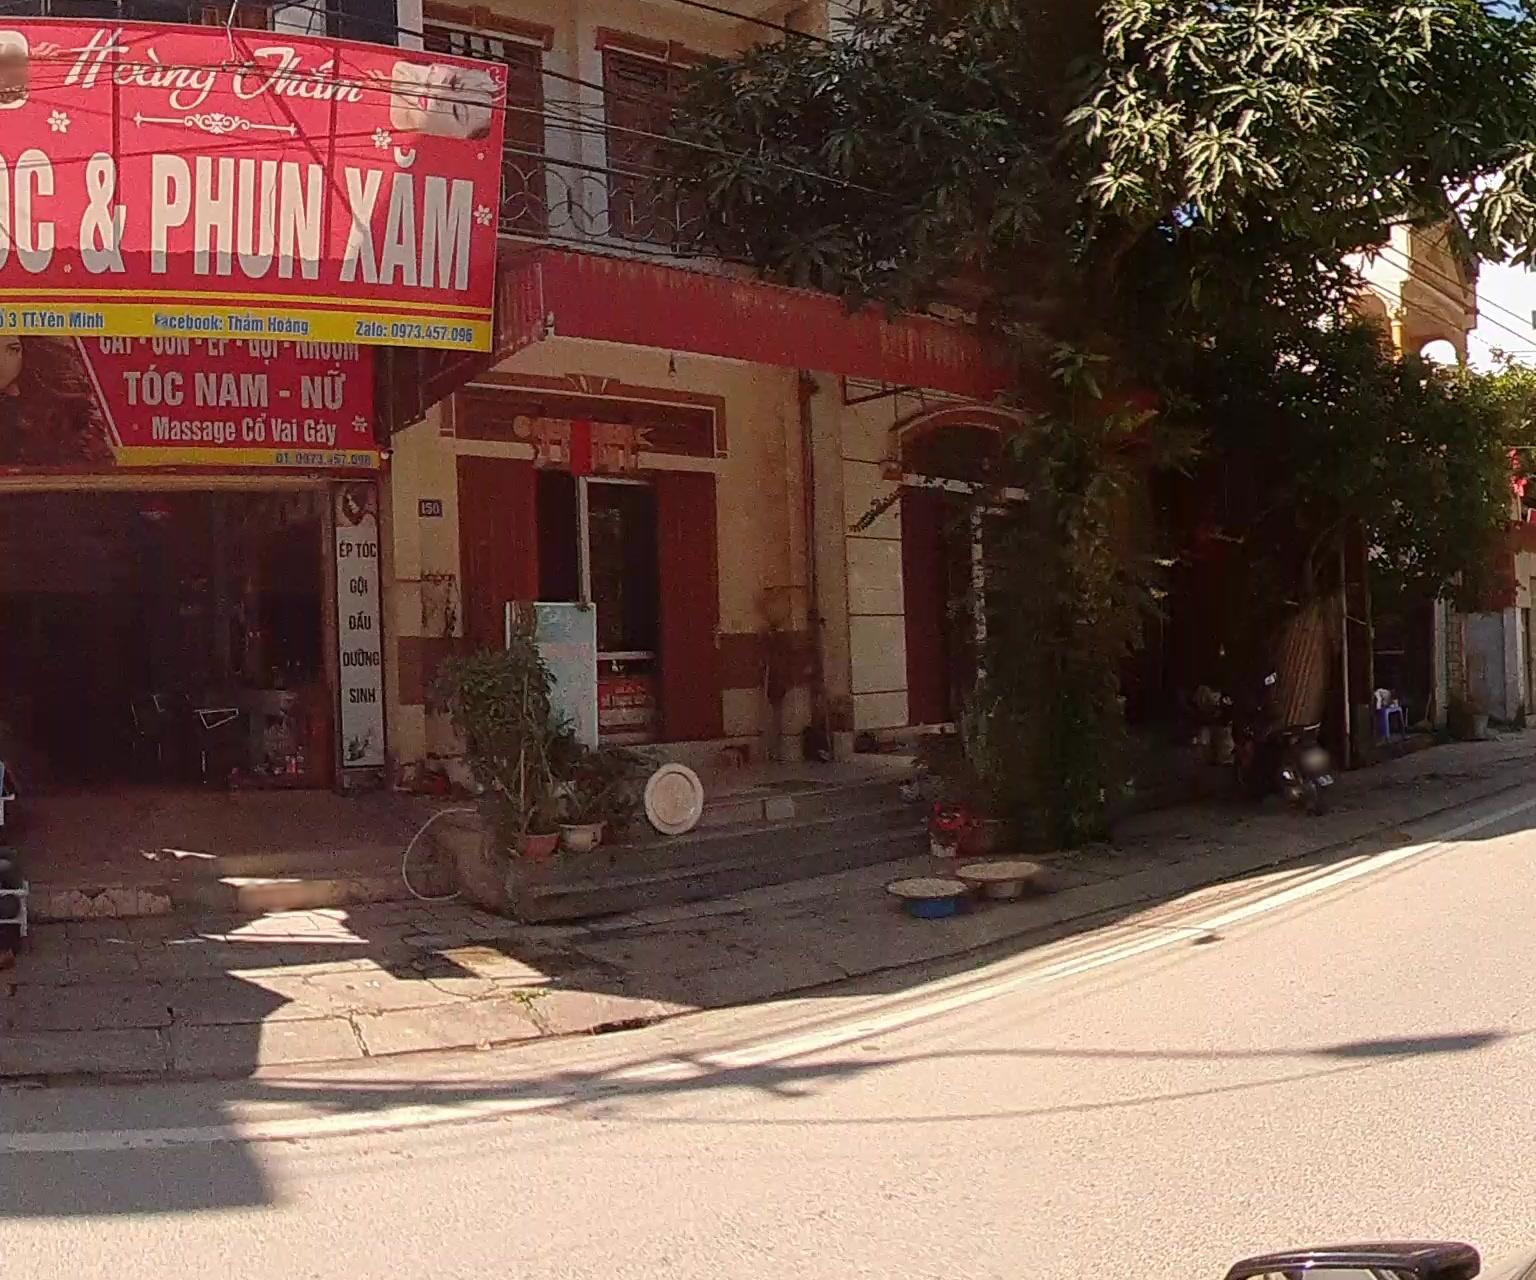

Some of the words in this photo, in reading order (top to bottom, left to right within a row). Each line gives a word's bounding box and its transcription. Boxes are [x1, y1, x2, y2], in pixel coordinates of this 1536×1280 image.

[65, 27, 216, 111] Hoàng
[81, 151, 127, 275] &
[150, 154, 322, 280] PHUN
[338, 146, 474, 292] XĂM
[9, 312, 17, 328] 3
[70, 311, 104, 329] Minh
[154, 313, 223, 331] Facebook:
[355, 320, 387, 337] Zalo:
[123, 365, 184, 407] TÓC
[194, 371, 270, 409] NAM
[301, 370, 347, 410] NỮ
[151, 416, 236, 445] Massage
[242, 412, 267, 442] Cổ
[271, 417, 298, 442] Vai
[303, 418, 337, 447] Gáy
[421, 501, 441, 515] 150
[339, 541, 353, 558] ÉP
[356, 540, 378, 558] TÓC
[350, 575, 368, 597] GỘI
[349, 687, 377, 704] SINH
